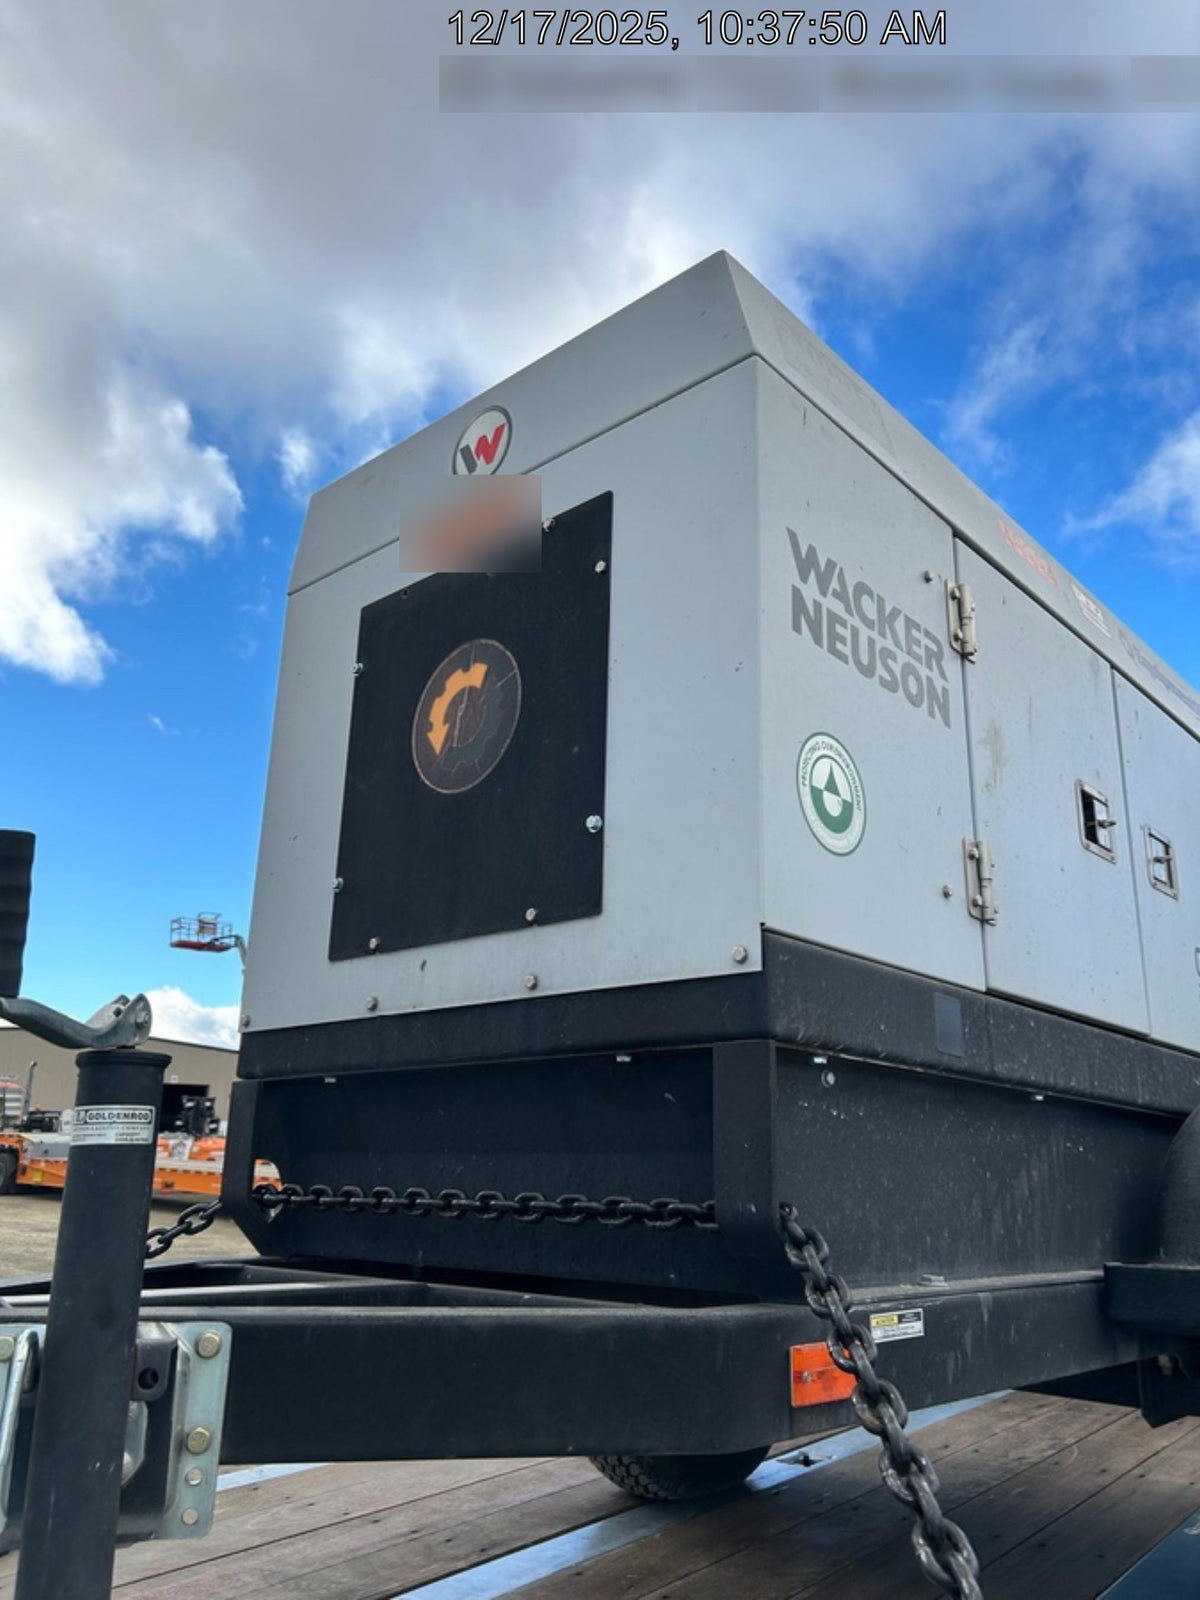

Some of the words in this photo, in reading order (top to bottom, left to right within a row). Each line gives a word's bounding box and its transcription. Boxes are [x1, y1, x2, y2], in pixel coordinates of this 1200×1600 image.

[786, 526, 949, 683] WACKER
[791, 583, 950, 730] NEUSON
[88, 1112, 150, 1121] GOLDENROD
